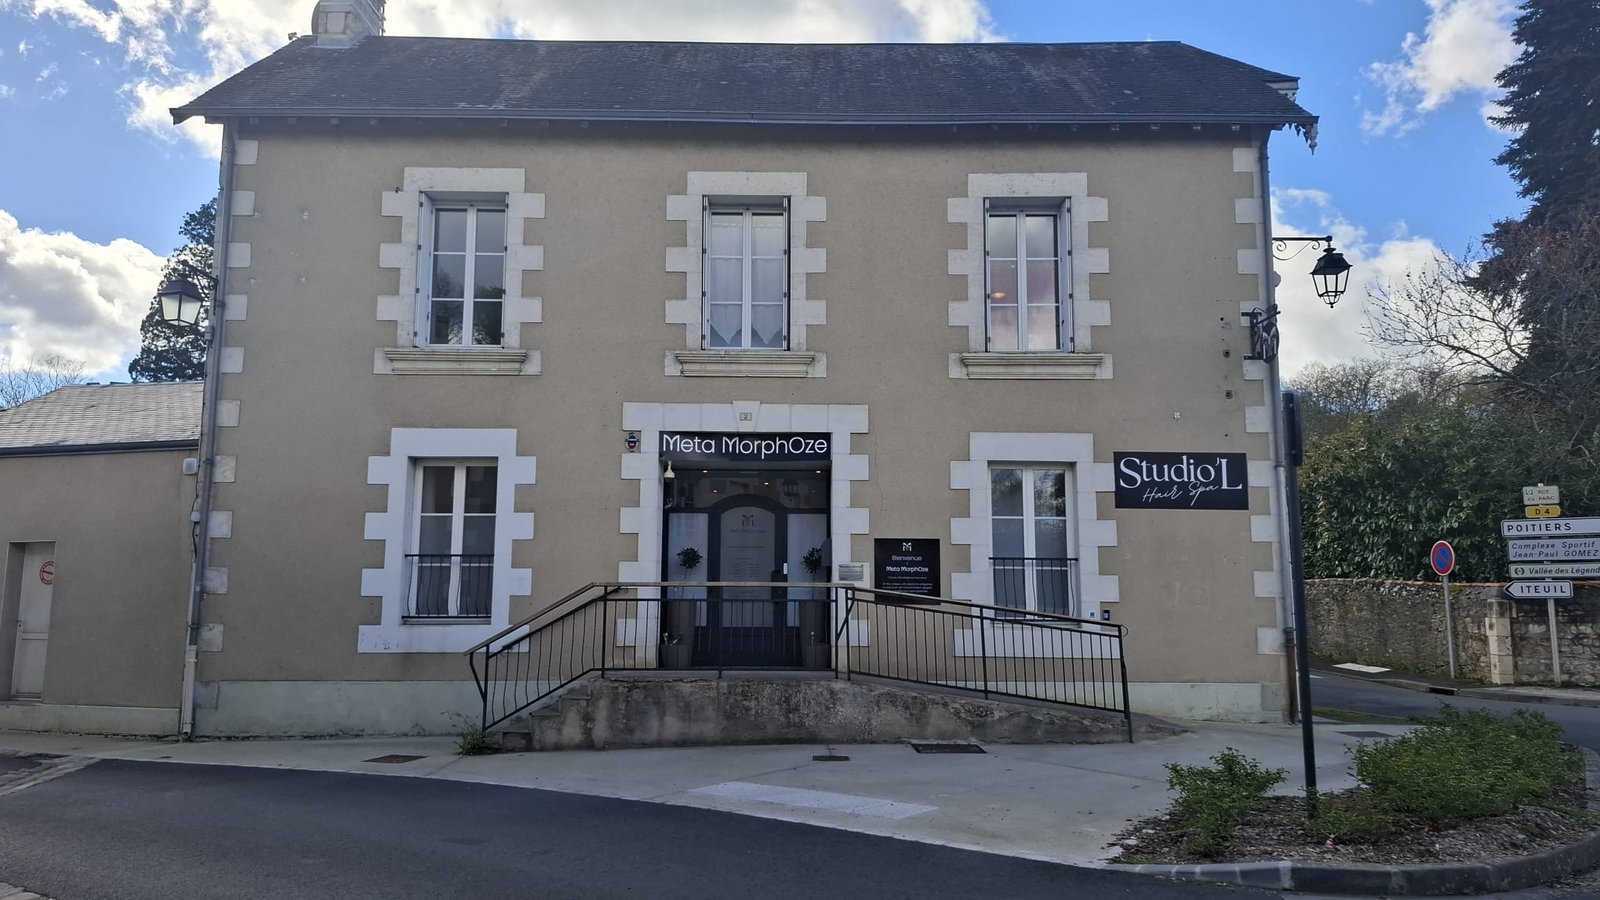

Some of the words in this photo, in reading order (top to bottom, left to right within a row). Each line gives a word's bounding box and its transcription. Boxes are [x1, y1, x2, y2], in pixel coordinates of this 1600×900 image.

[662, 434, 715, 453] Meta
[722, 436, 828, 459] MorphOze
[1119, 454, 1243, 489] Studio'L
[1142, 484, 1183, 502] Hair
[1188, 481, 1219, 506] Spa
[1507, 522, 1572, 533] POITIERS
[1511, 543, 1556, 551] Complexe
[1561, 541, 1595, 550] Sportif
[1563, 549, 1599, 557] GOMEZ
[1529, 567, 1553, 575] Vallée
[1520, 585, 1567, 594] ITEUIL
